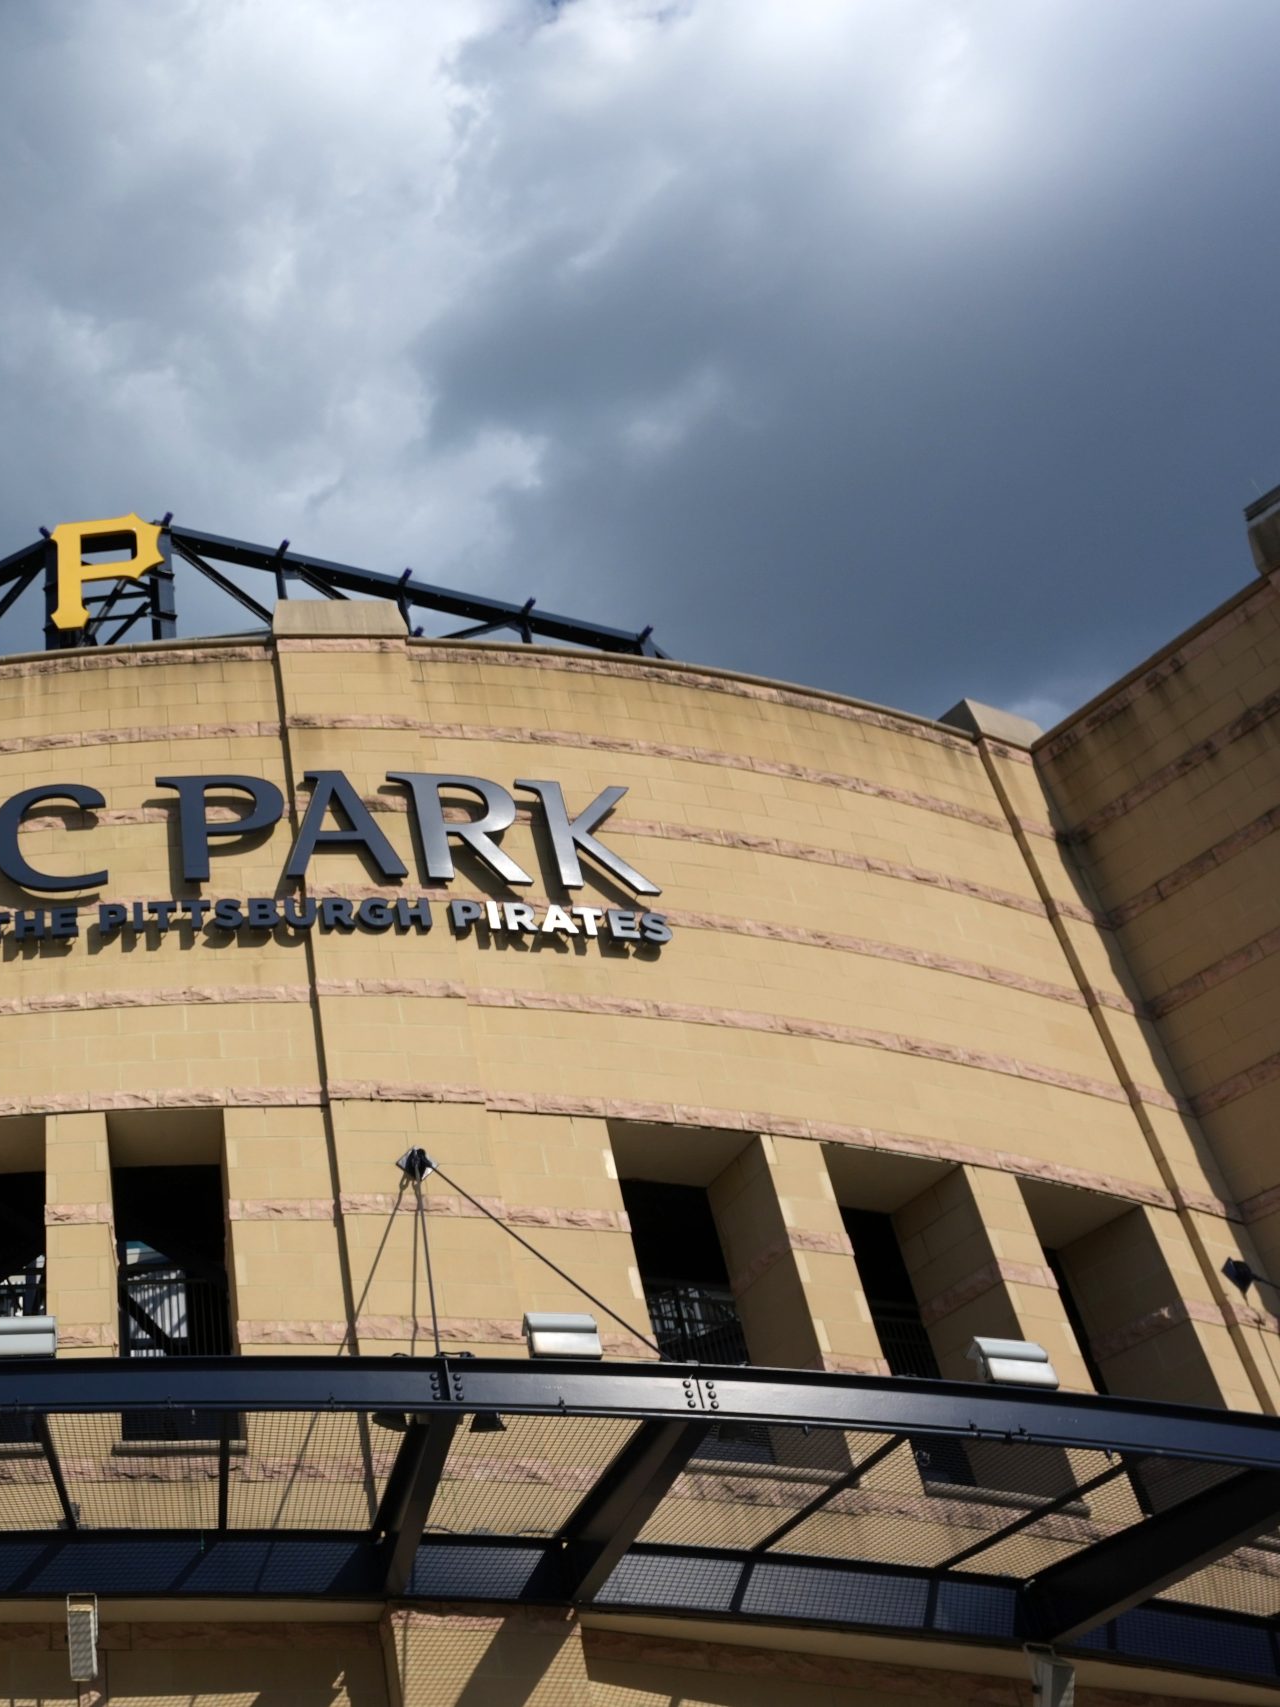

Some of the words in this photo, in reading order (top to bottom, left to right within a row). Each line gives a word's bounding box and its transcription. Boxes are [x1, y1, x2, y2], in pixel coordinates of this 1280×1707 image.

[50, 512, 164, 629] P
[155, 770, 662, 896] PARK
[98, 897, 433, 935] PITTSBURGH
[451, 899, 674, 945] PIRATES
